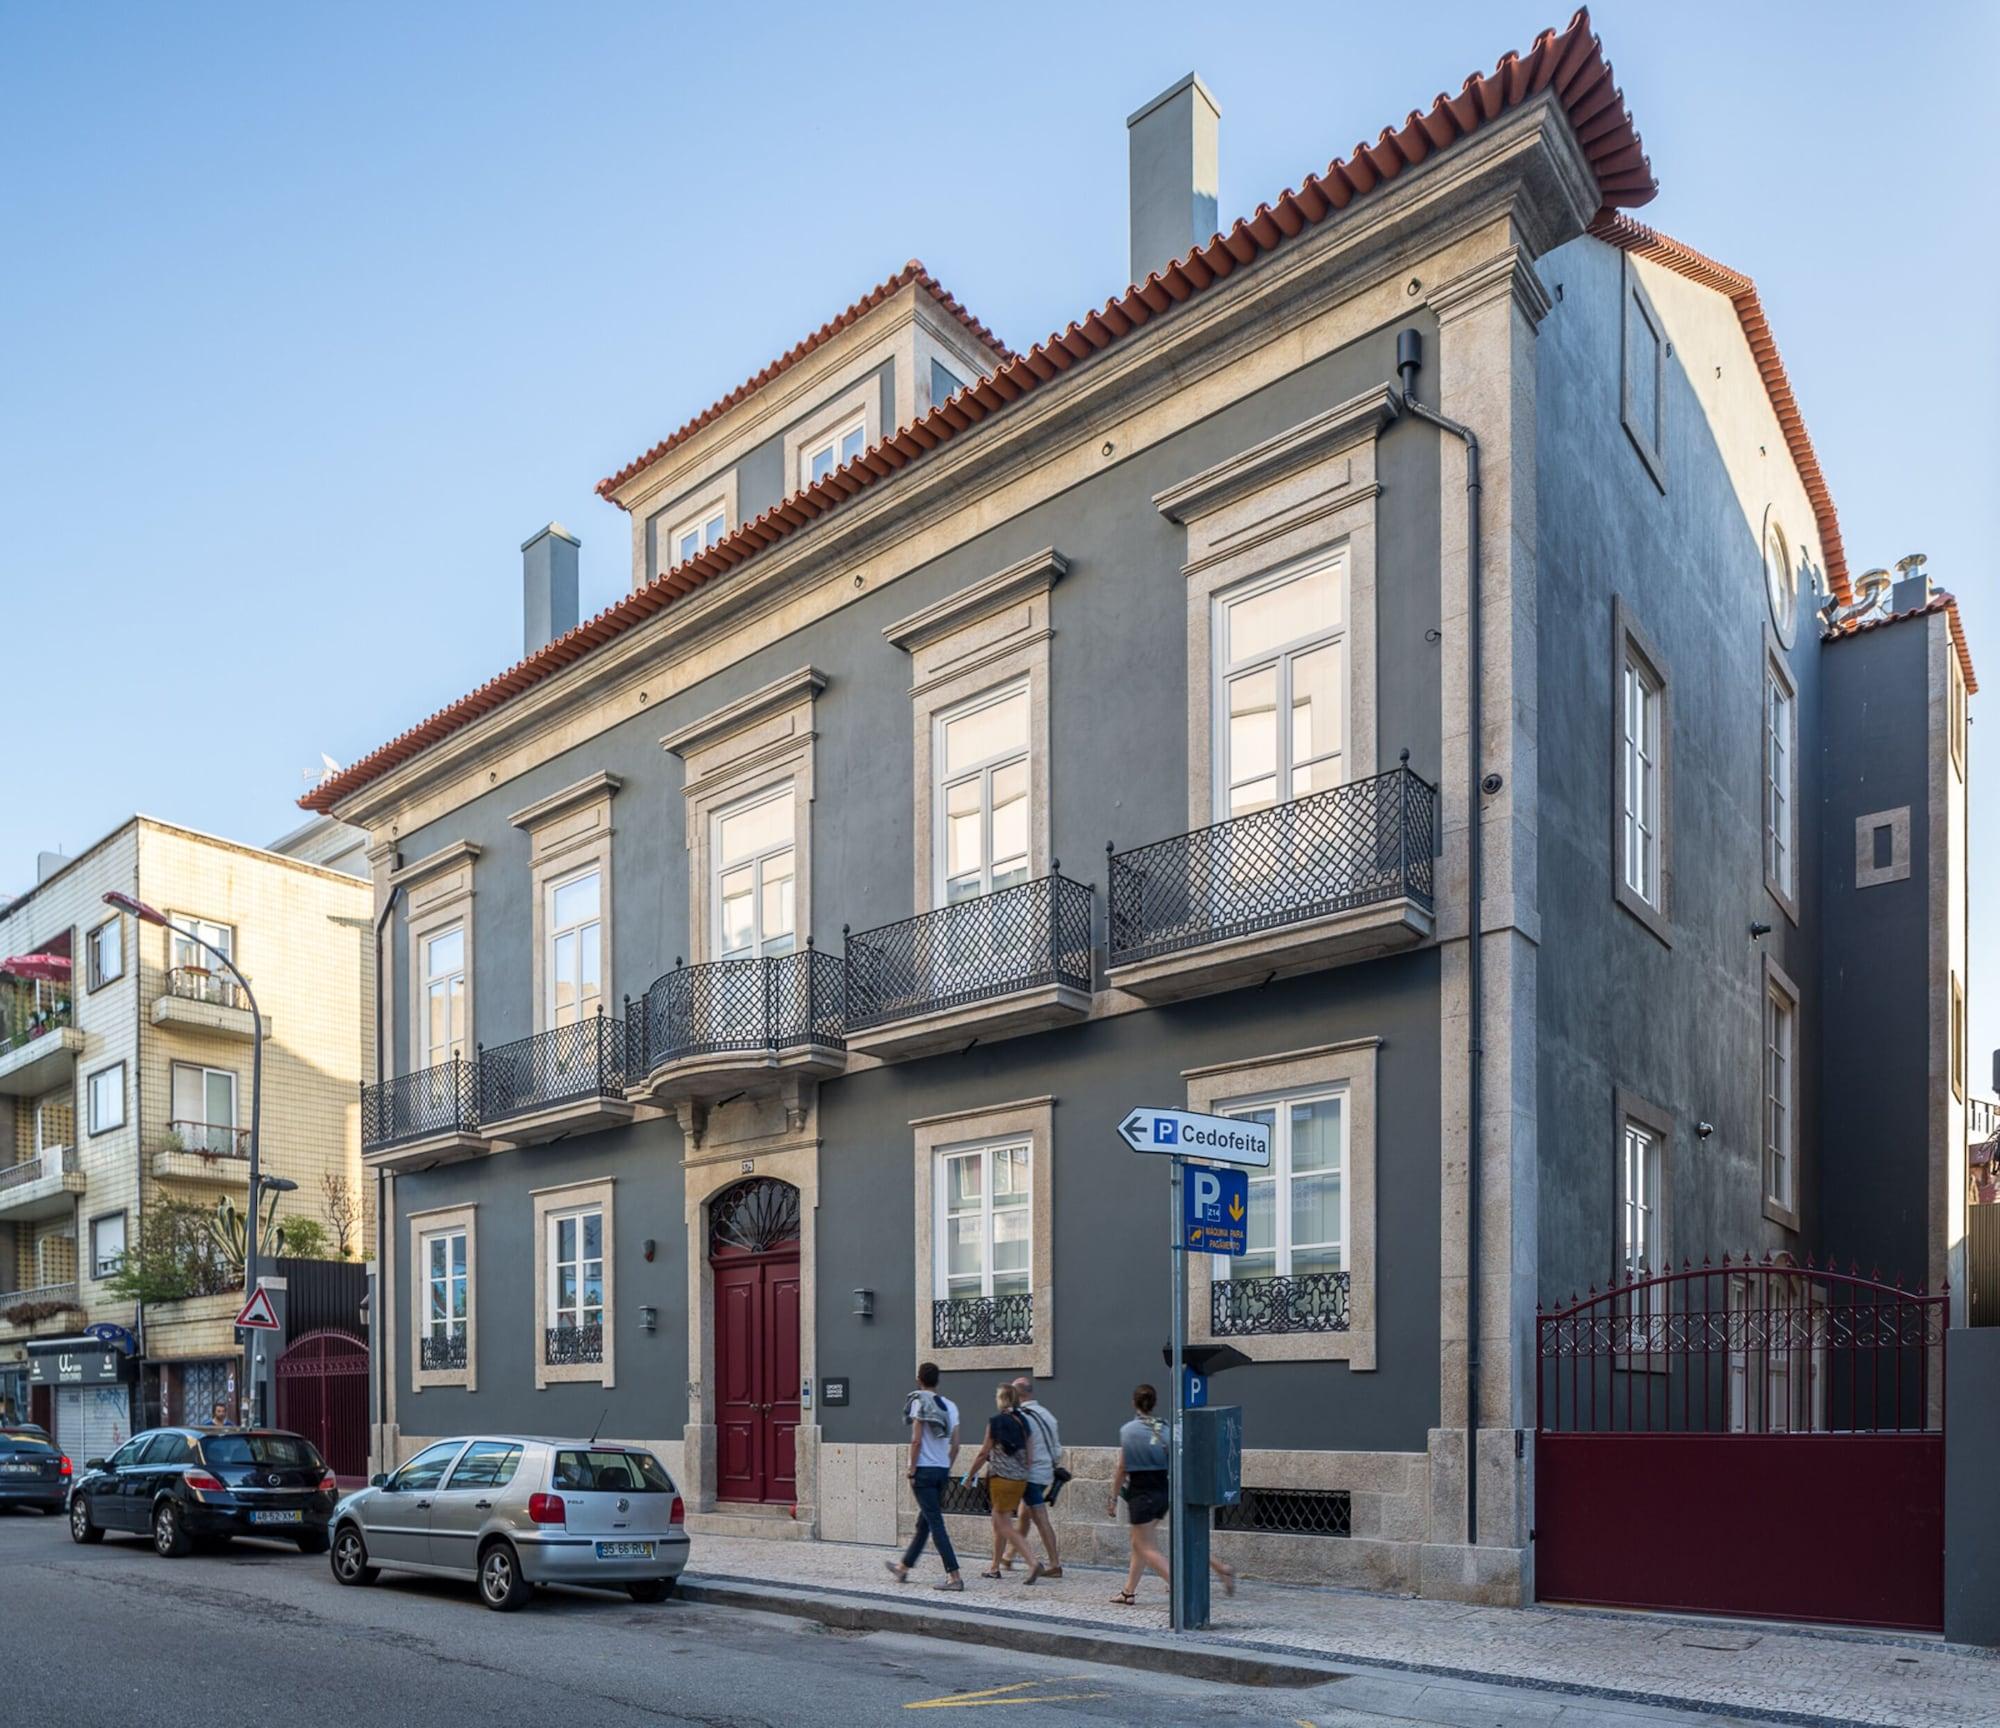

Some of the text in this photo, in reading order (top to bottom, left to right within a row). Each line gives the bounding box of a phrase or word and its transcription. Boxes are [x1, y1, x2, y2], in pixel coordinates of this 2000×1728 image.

[1159, 1122, 1266, 1153] P Cedofeita
[1194, 1171, 1221, 1219] P
[1191, 1378, 1201, 1403] P
